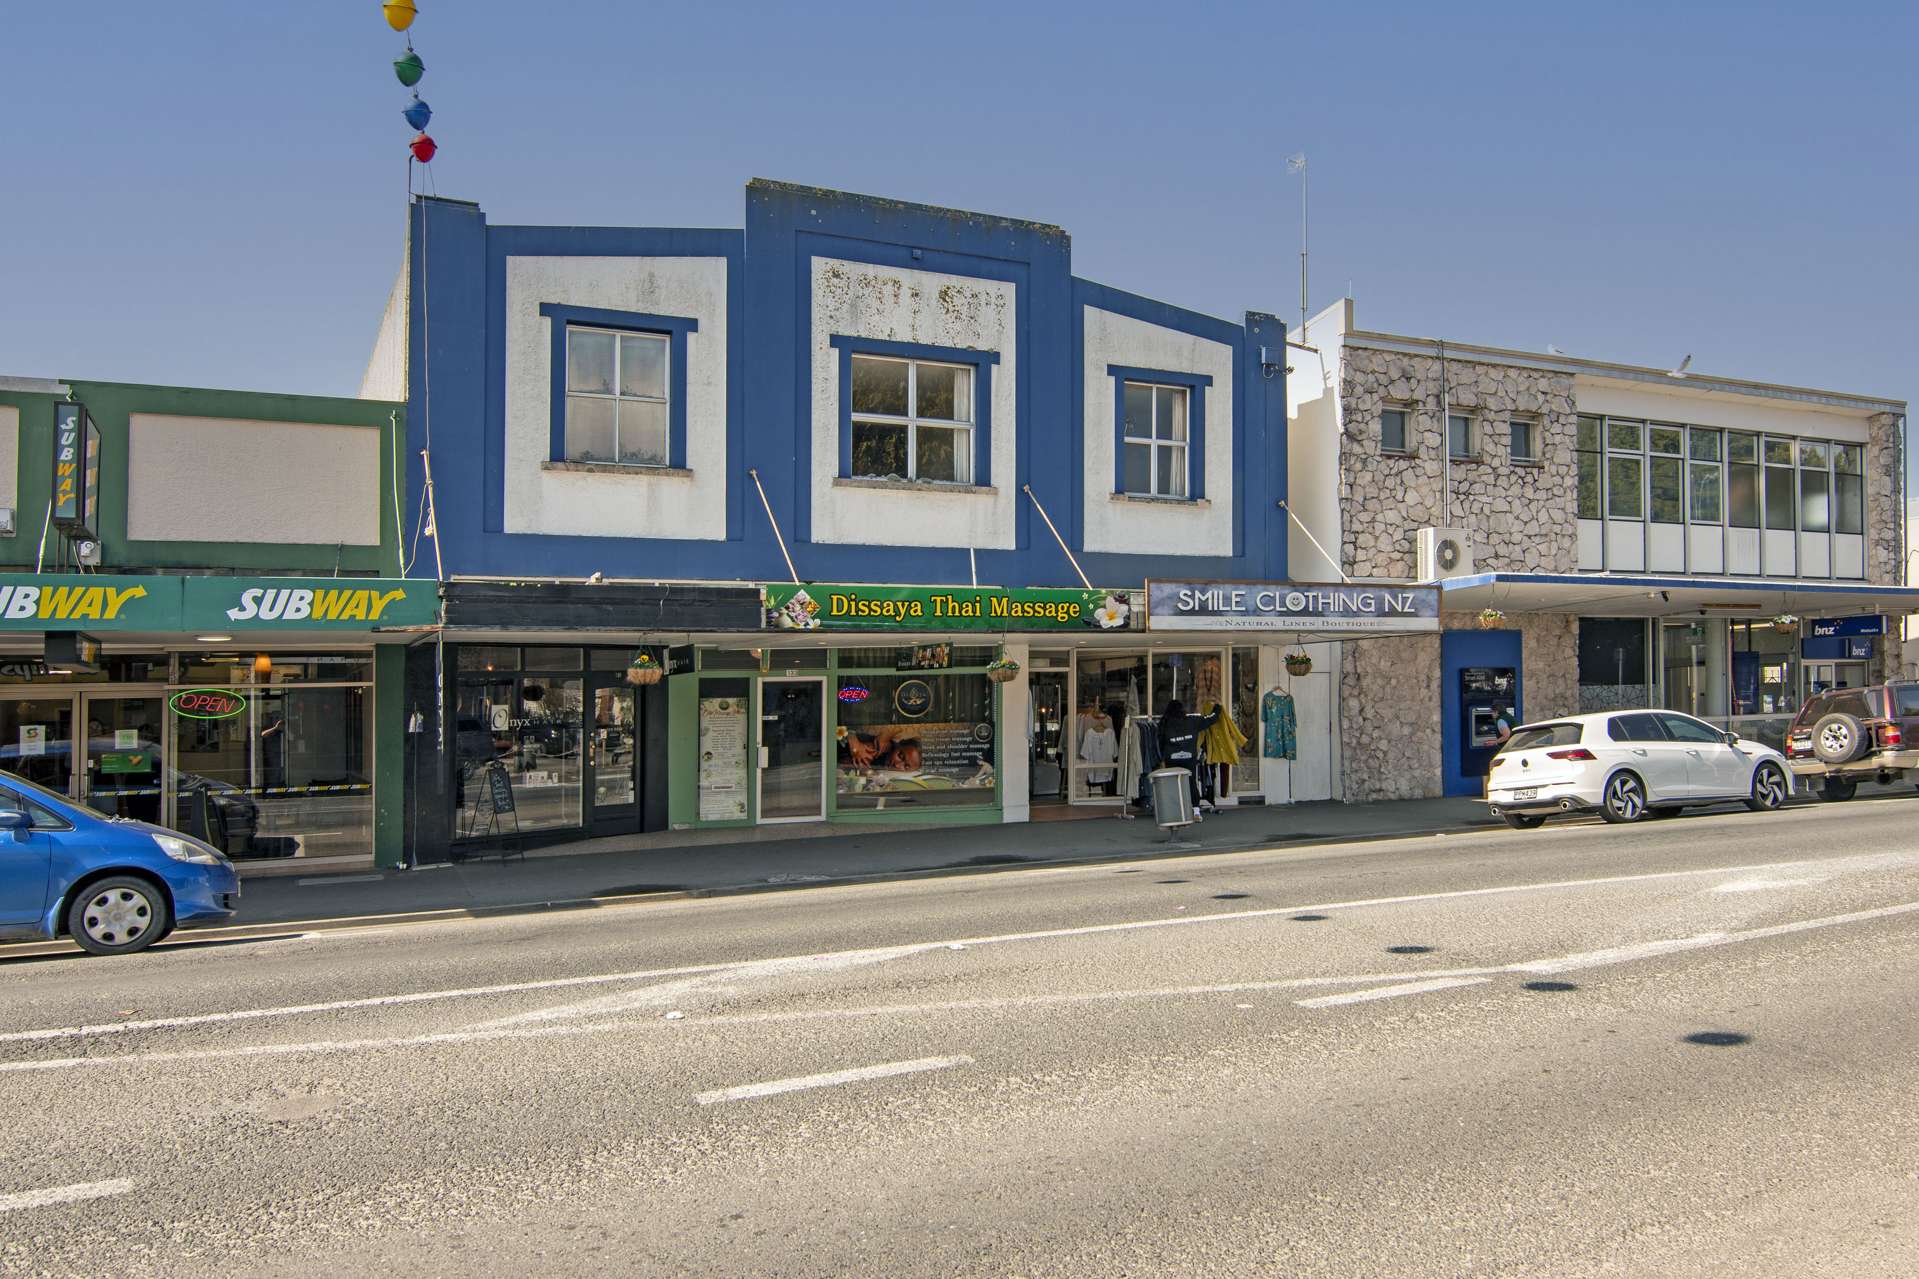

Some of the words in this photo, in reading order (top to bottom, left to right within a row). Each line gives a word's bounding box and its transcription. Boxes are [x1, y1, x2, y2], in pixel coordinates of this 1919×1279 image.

[57, 416, 77, 507] SUBWAY
[227, 588, 407, 622] SUBWAY
[830, 595, 923, 621] Dissaya
[931, 596, 981, 617] Thai
[990, 597, 1080, 621] Massage
[1176, 589, 1246, 611] SMILE
[1256, 591, 1376, 612] CLOTHING
[1384, 593, 1416, 613] NZ
[1814, 625, 1835, 636] bnz
[1852, 645, 1866, 656] bnz
[180, 694, 236, 713] OPEN
[838, 690, 869, 699] OPEN
